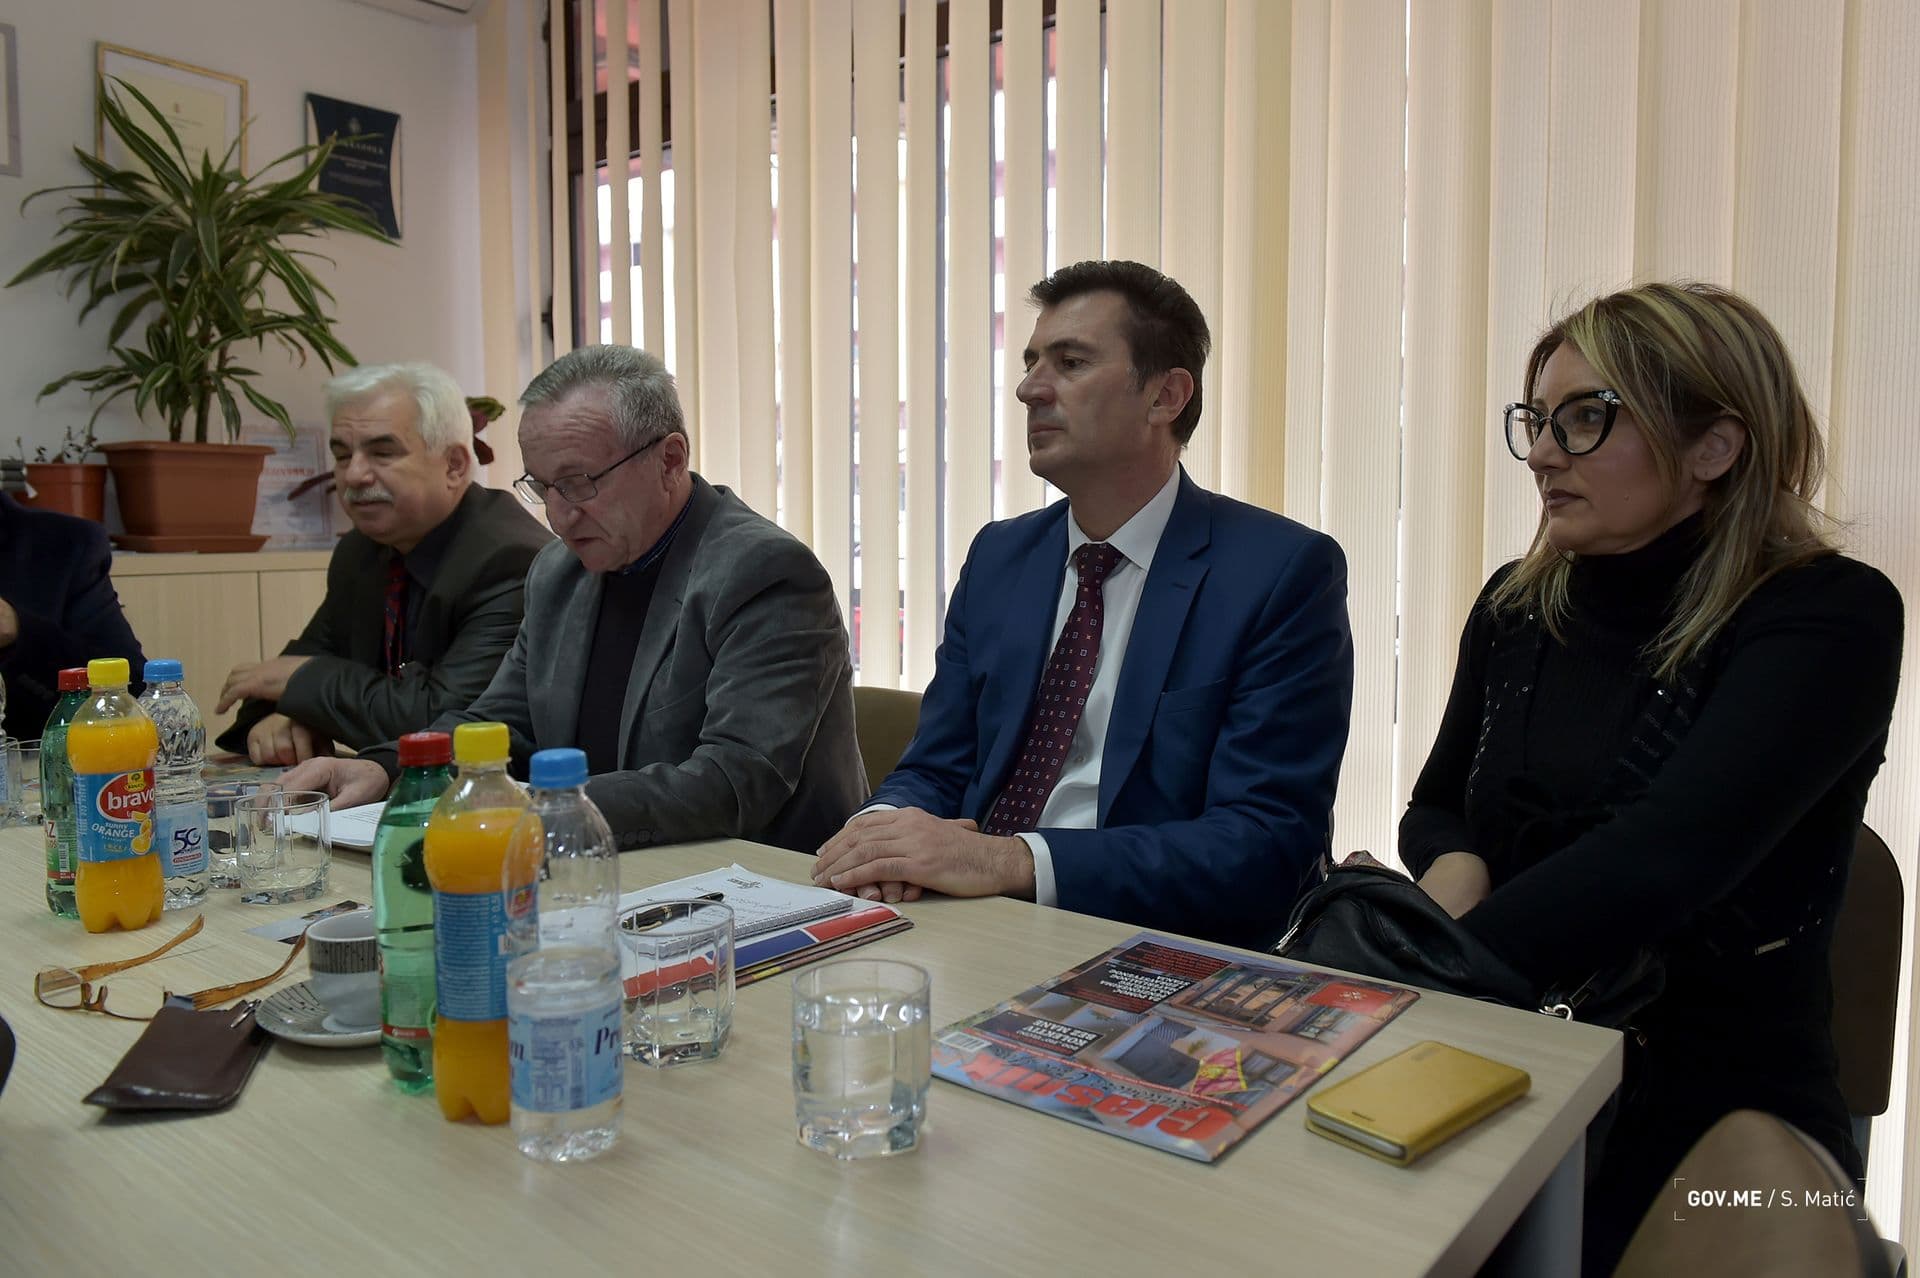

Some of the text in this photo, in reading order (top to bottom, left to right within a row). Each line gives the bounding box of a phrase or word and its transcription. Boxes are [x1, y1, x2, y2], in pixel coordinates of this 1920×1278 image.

[108, 788, 154, 810] bravo
[92, 823, 134, 838] ORANGE
[1022, 1025, 1088, 1047] KOLEKTIV
[1032, 1019, 1097, 1041] BEZ MANE
